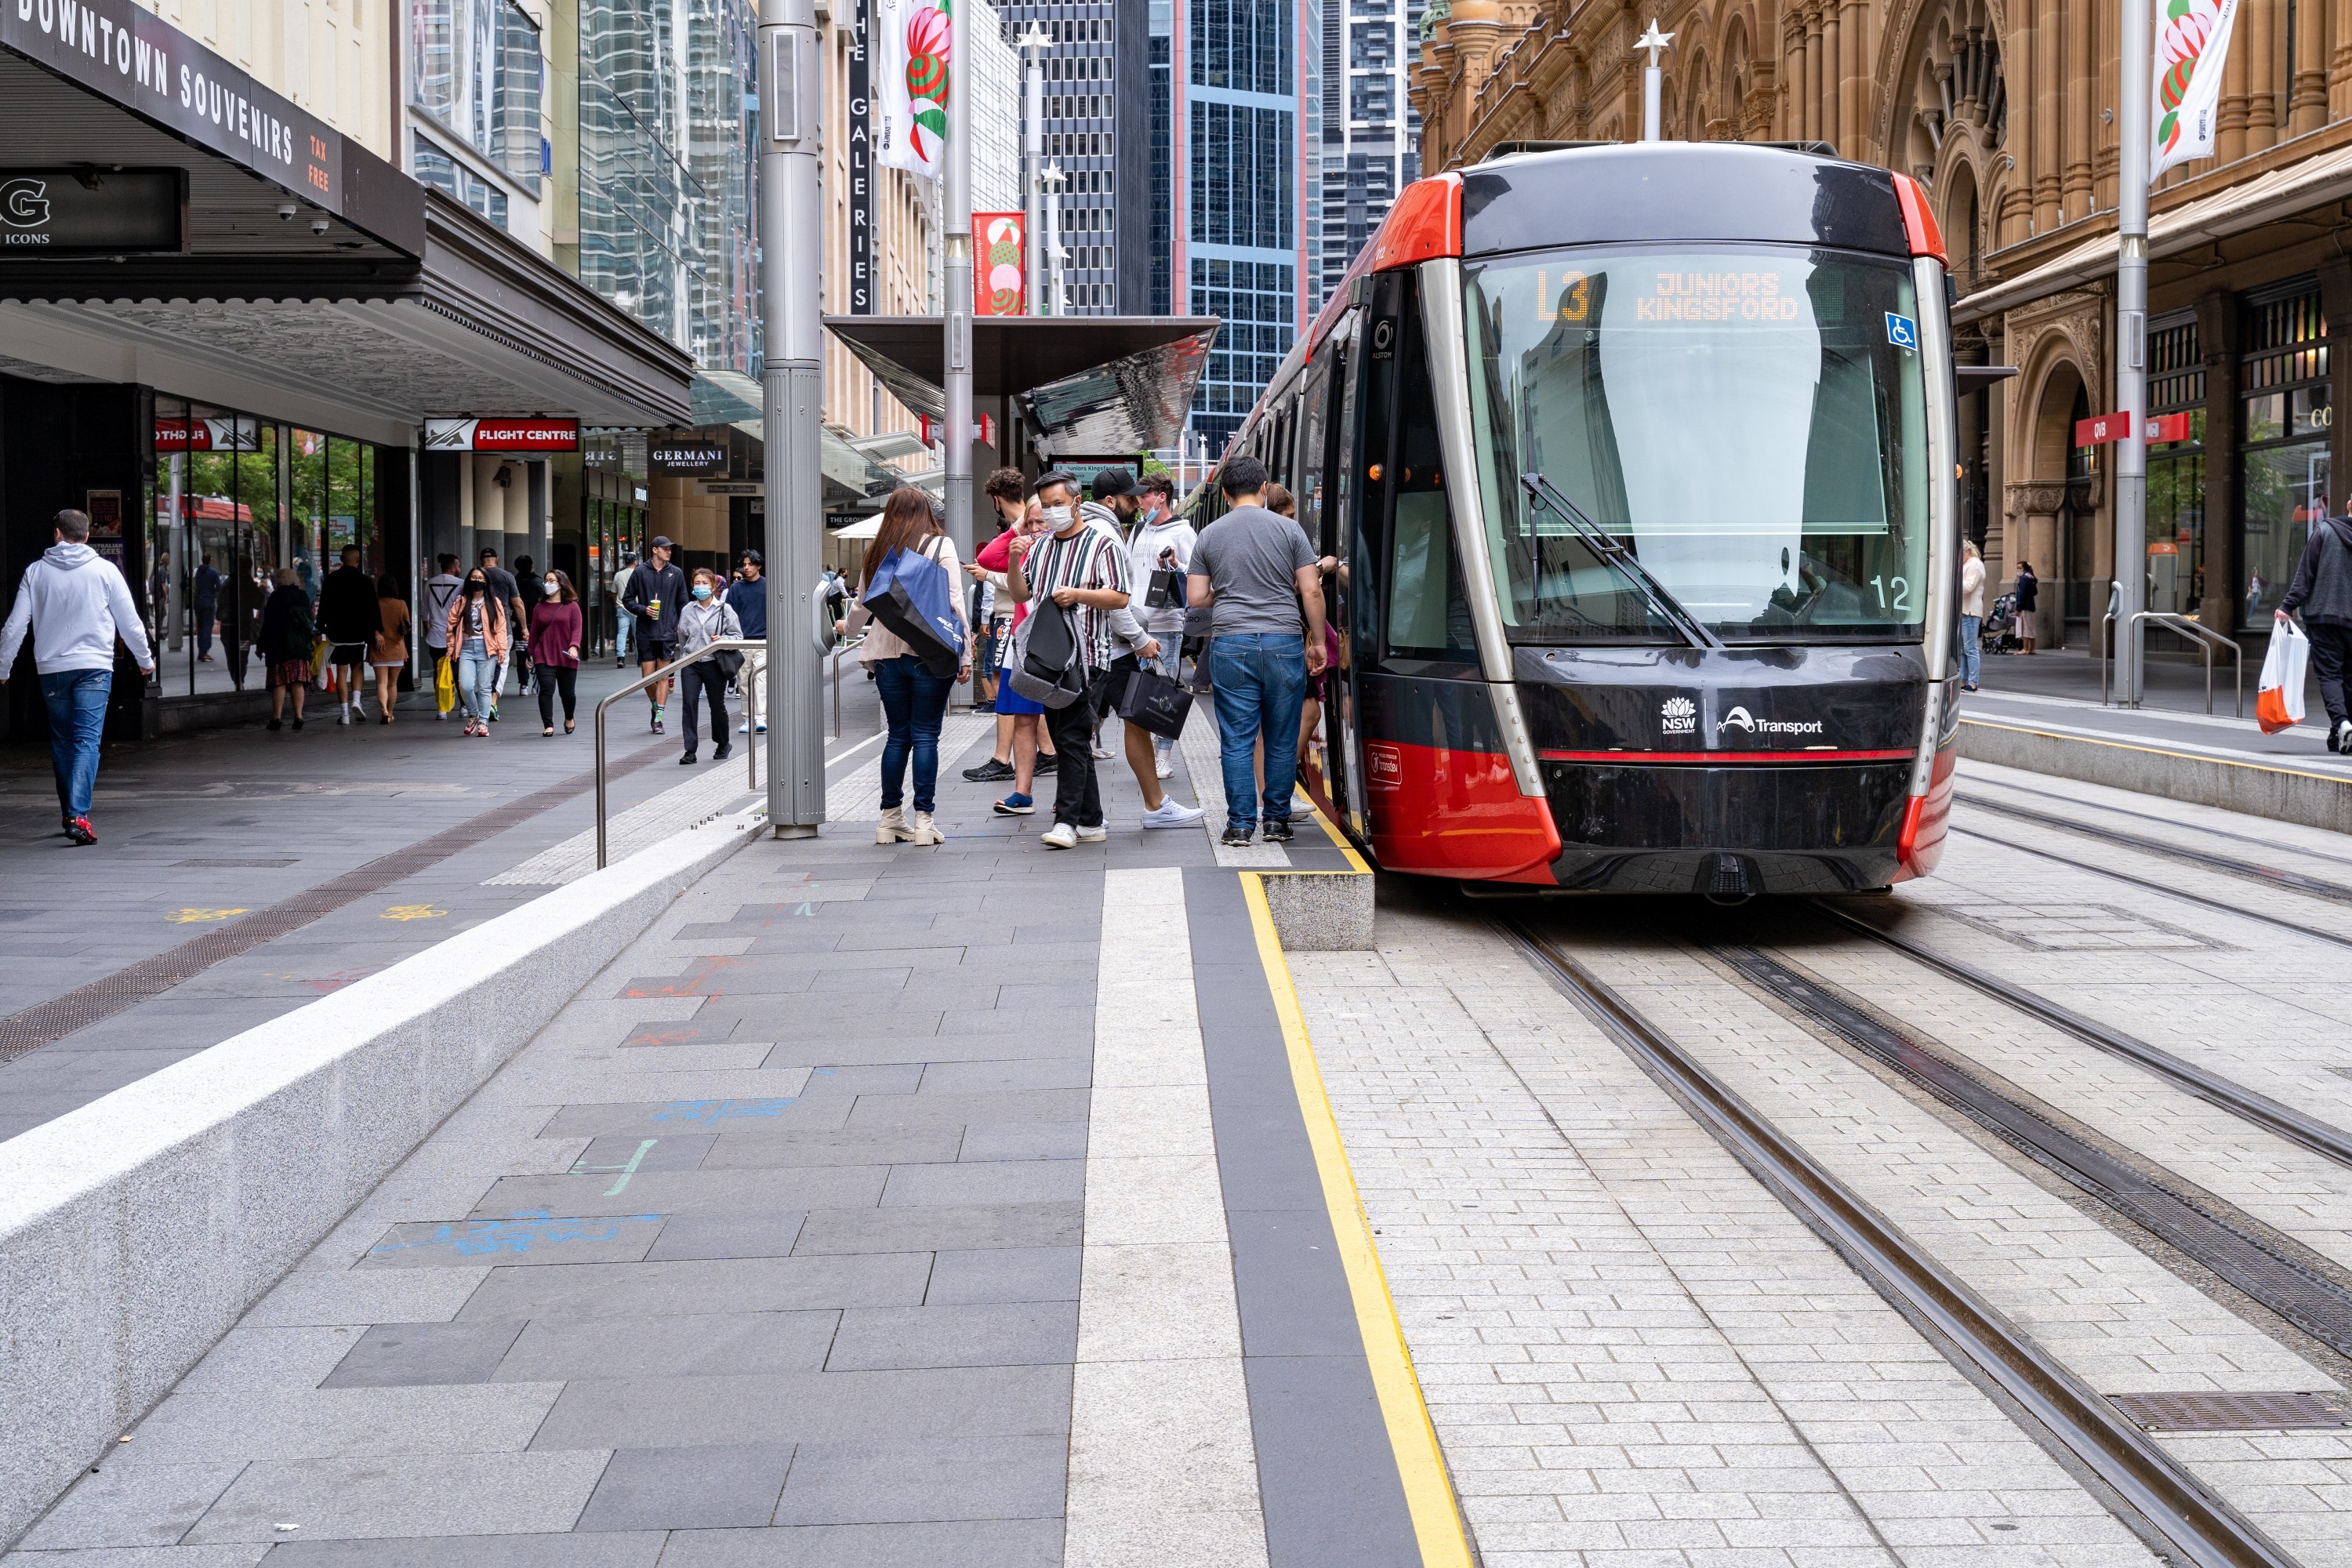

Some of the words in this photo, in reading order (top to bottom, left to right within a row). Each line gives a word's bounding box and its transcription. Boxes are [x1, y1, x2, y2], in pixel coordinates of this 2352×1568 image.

[180, 64, 292, 165] SOUVENIRS
[310, 135, 326, 162] TAX
[309, 164, 328, 192] FREE
[851, 98, 868, 306] GALERIES
[5, 234, 49, 244] ICONS
[1538, 271, 1588, 320] L3
[1657, 273, 1779, 296] JUNIORS
[1637, 298, 1798, 320] KINGSFORD
[479, 430, 524, 439] FLIGHT
[526, 430, 575, 440] CENTRE
[2095, 422, 2106, 440] QVB
[653, 451, 722, 460] GERMANI
[1870, 575, 1911, 611] 12
[994, 618, 1013, 666] ellesse
[1663, 717, 1696, 729] NSW
[1755, 719, 1823, 735] Transport
[1379, 760, 1398, 772] transdev
